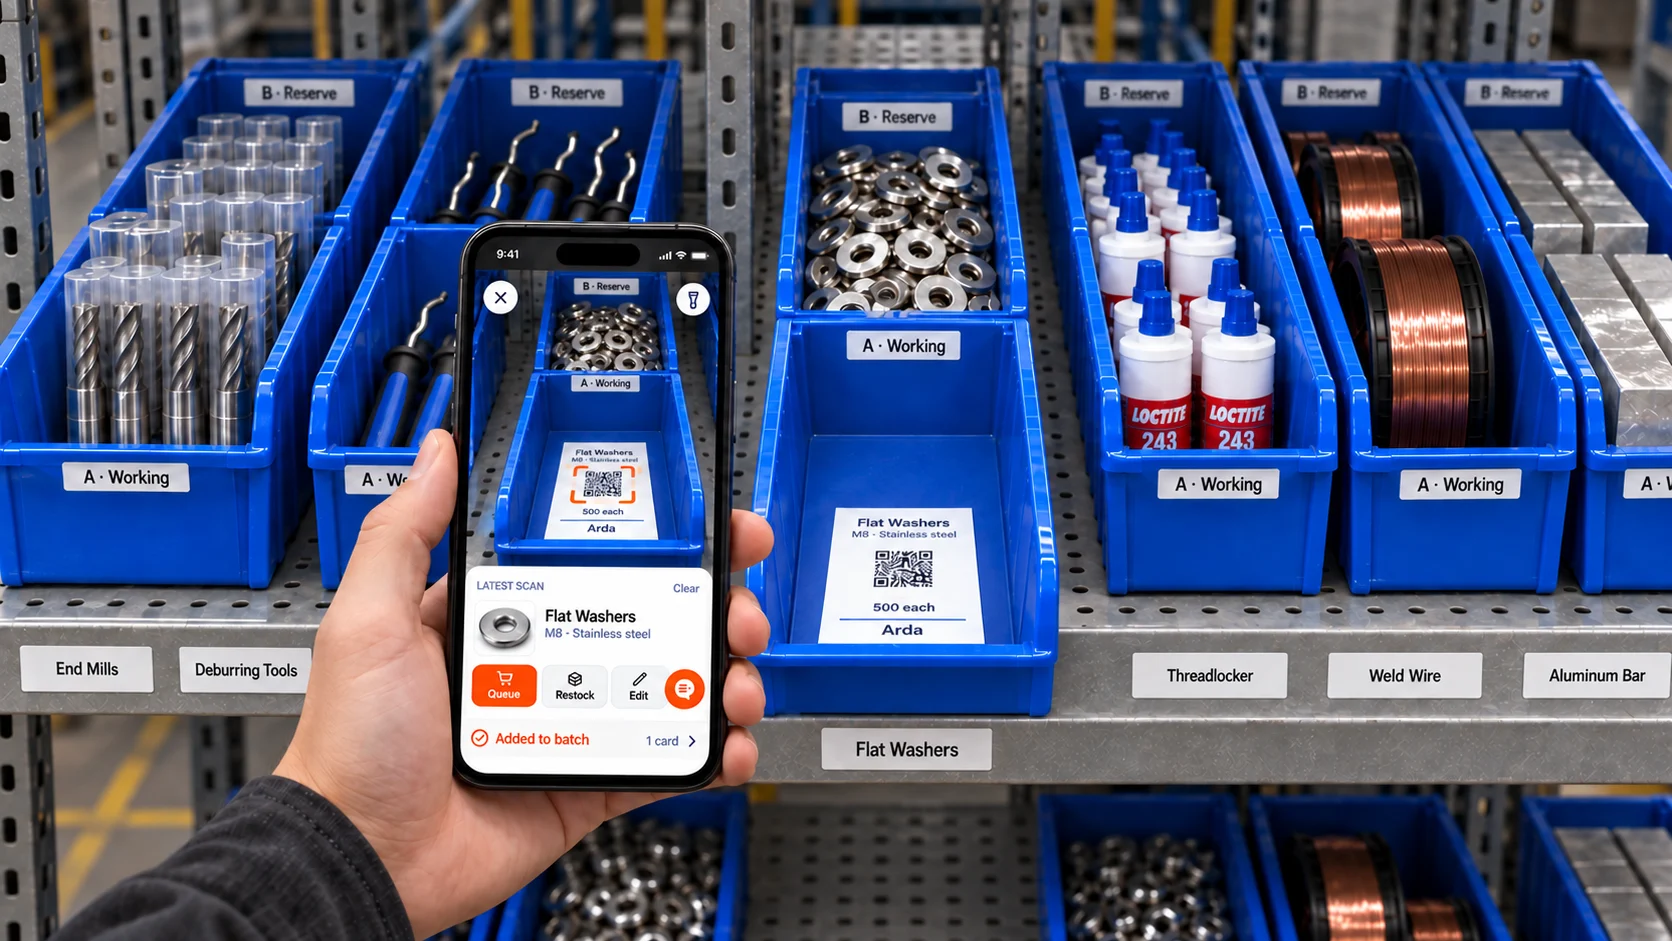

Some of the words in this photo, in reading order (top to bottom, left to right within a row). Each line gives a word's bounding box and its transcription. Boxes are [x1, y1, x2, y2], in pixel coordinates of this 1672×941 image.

[262, 85, 273, 100] B
[284, 85, 337, 100] Reserve
[529, 85, 540, 100] B
[552, 85, 605, 100] Reserve
[1100, 86, 1110, 101] B
[1121, 86, 1170, 100] Reserve
[1297, 84, 1308, 100] B
[1318, 85, 1368, 100] Reserve
[1480, 84, 1491, 100] B
[1502, 85, 1550, 100] Reserve
[859, 109, 870, 124] B
[882, 109, 936, 124] Reserve
[496, 249, 519, 259] 9:41
[583, 282, 590, 291] B
[597, 282, 630, 291] Reserve
[862, 338, 874, 352] A
[887, 338, 946, 356] Working
[580, 378, 588, 387] A
[595, 379, 631, 390] Working
[1132, 404, 1187, 425] LOCTITE
[1209, 404, 1266, 424] LOCTITE
[1142, 430, 1177, 450] 243
[1218, 430, 1254, 450] 243
[84, 469, 96, 484] A
[108, 469, 169, 488] Working
[362, 472, 374, 486] A
[1175, 476, 1187, 491] A
[1201, 476, 1262, 495] Working
[1417, 477, 1429, 492] A
[1443, 476, 1504, 495] Working
[1640, 476, 1653, 491] A
[587, 524, 616, 532] Arda
[858, 518, 884, 527] Flat
[888, 518, 950, 528] Washers
[477, 581, 514, 590] LATEST
[516, 581, 544, 591] SCAN
[673, 583, 700, 593] Clear
[873, 603, 900, 612] 500
[902, 602, 935, 612] each
[546, 608, 572, 622] Flat
[575, 609, 636, 623] Washers
[545, 628, 563, 638] M8
[572, 628, 622, 639] Stainless
[625, 628, 651, 639] steel
[882, 624, 923, 636] Arda
[56, 661, 82, 676] End
[87, 662, 119, 676] Mills
[196, 662, 260, 680] Deburring
[262, 663, 298, 677] Tools
[1167, 668, 1254, 682] Threadlocker
[1369, 668, 1404, 682] Weld
[1409, 668, 1441, 682] Wire
[1549, 668, 1618, 682] Aluminum
[1622, 668, 1646, 682] Bar
[488, 689, 520, 699] Queue
[556, 690, 595, 700] Restock
[629, 690, 648, 700] Edit
[495, 732, 535, 744] Added
[538, 734, 551, 745] to
[554, 733, 589, 745] batch
[646, 736, 651, 746] 1
[654, 735, 679, 746] card
[856, 741, 886, 757] Flat
[890, 741, 959, 757] Washers
